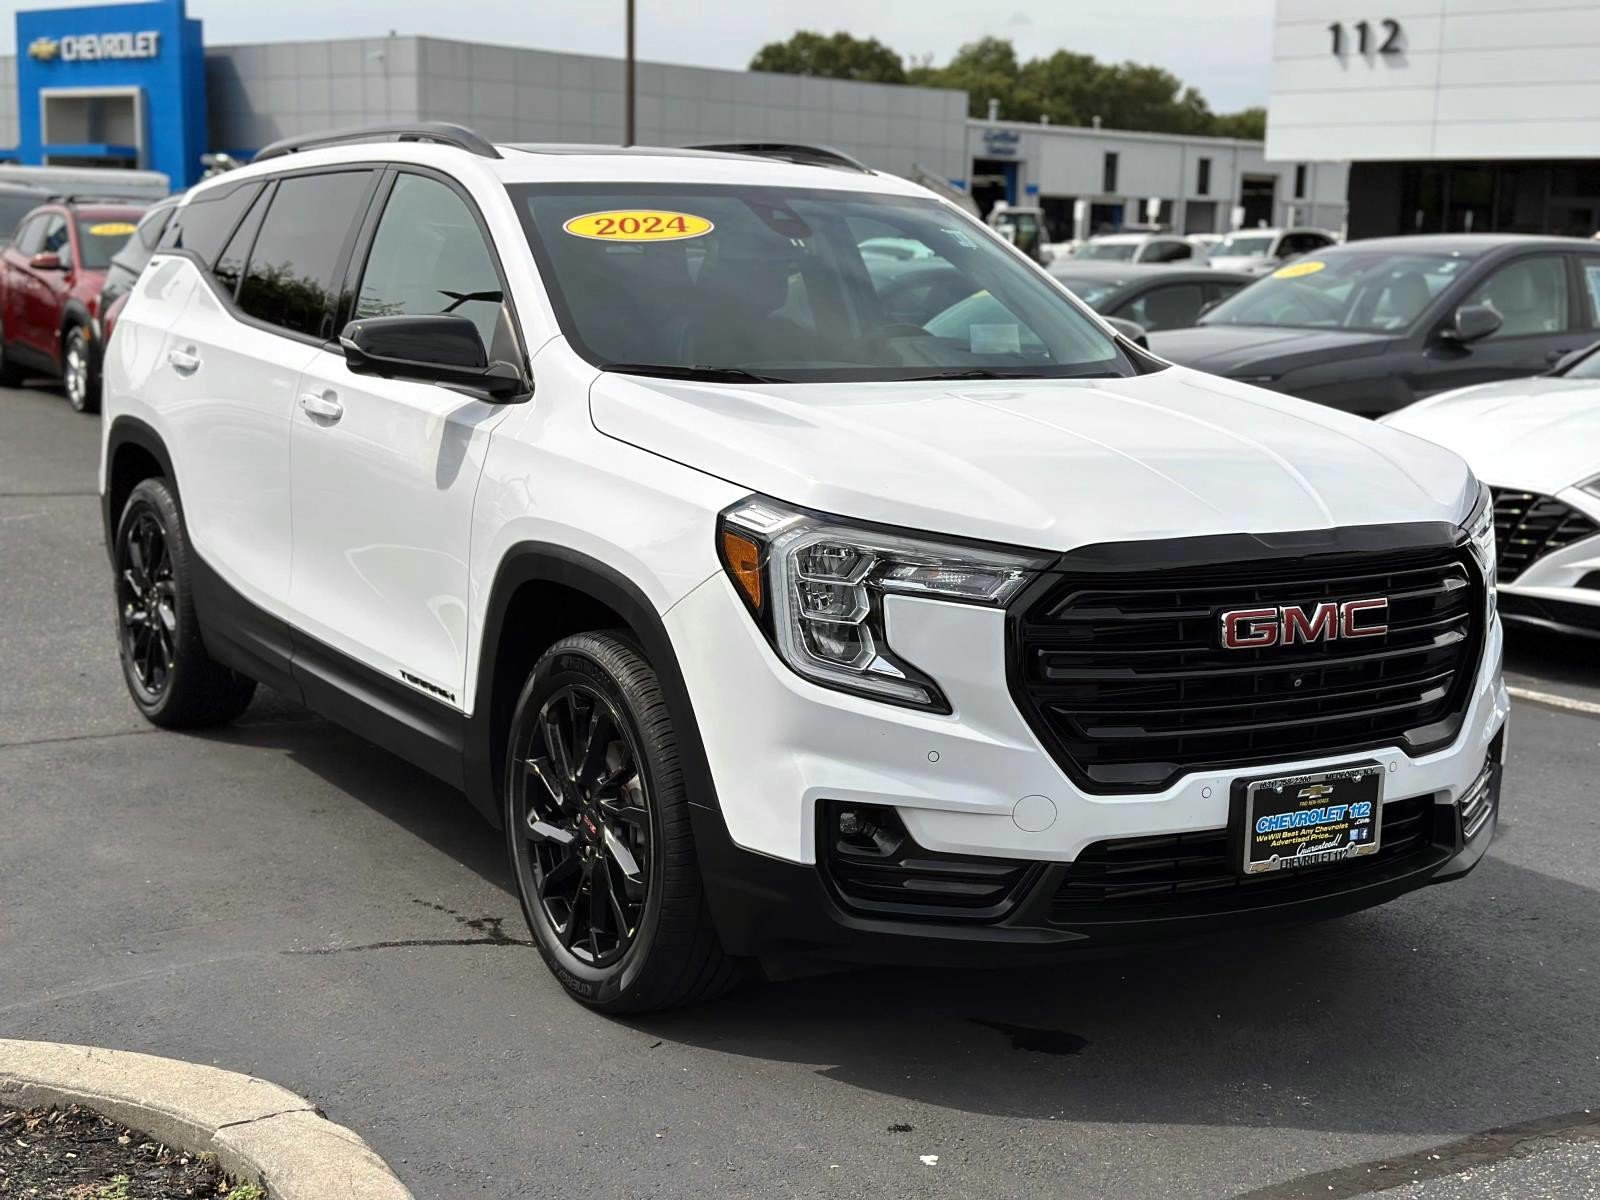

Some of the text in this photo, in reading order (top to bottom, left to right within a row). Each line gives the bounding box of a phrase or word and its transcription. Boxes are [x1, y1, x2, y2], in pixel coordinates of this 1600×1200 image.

[61, 31, 160, 61] CHEVROLET
[1328, 19, 1401, 55] 112
[594, 216, 690, 235] 2024
[1221, 598, 1388, 649] GMC
[1256, 801, 1371, 833] CHEVROLET 112
[1282, 830, 1299, 838] Beat
[1300, 828, 1314, 837] Any
[1315, 823, 1349, 833] Chevrolet
[1271, 836, 1310, 847] Advertised
